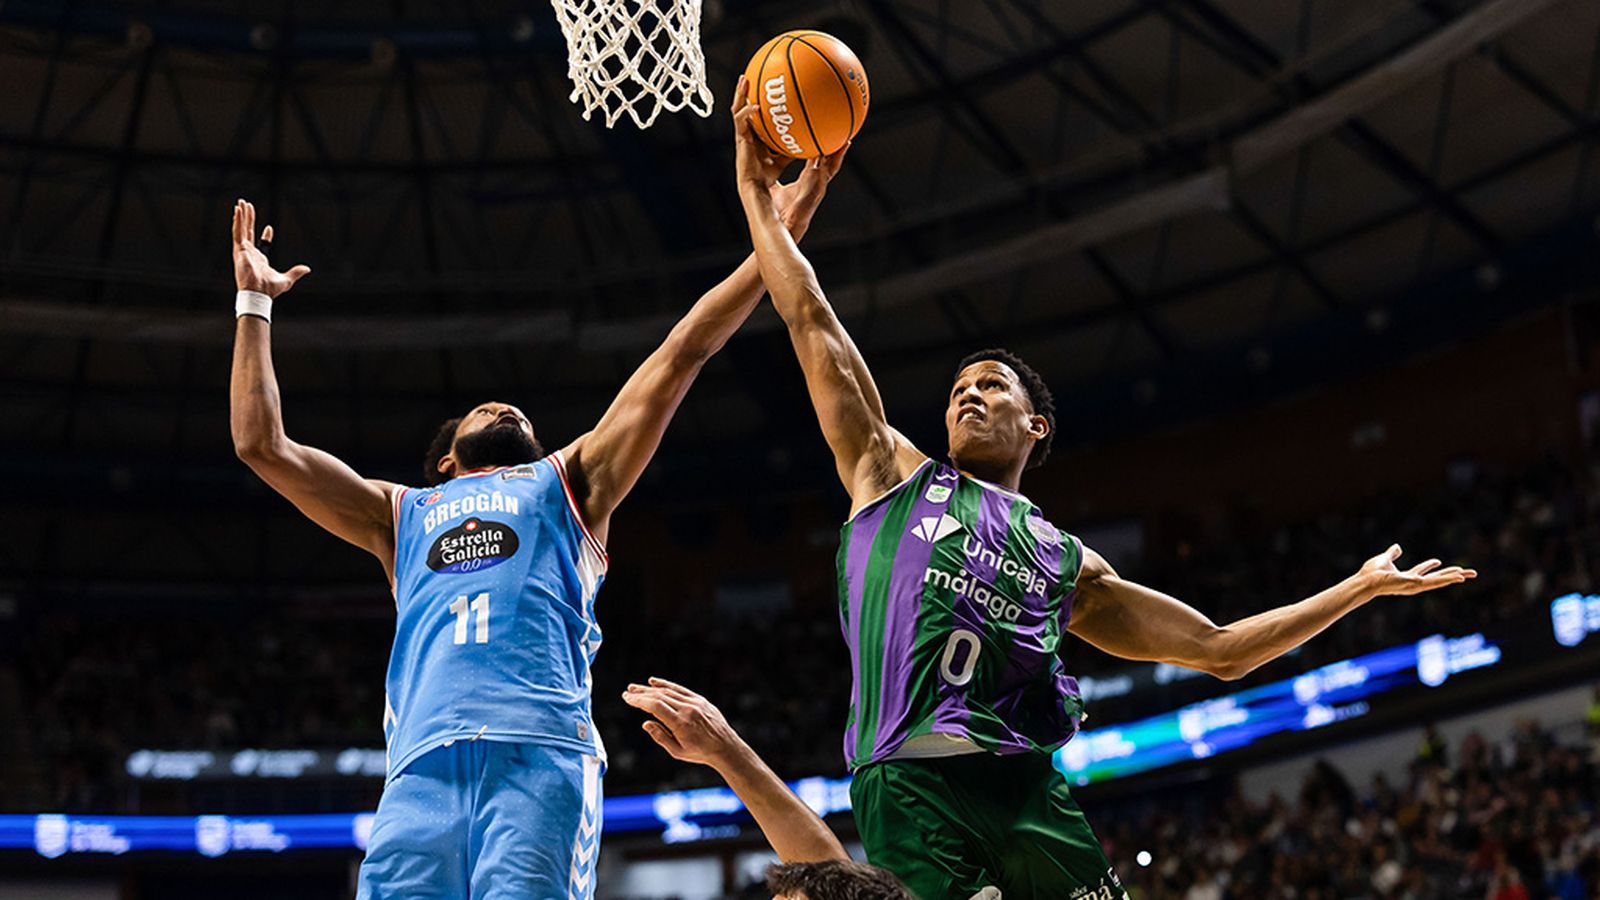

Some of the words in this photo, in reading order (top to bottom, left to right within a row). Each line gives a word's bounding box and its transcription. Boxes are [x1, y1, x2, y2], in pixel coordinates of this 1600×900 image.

[765, 75, 803, 154] Wilson
[423, 490, 519, 535] BREOGÁN
[440, 529, 504, 551] Estrella
[441, 542, 500, 564] Galicia
[962, 535, 1047, 597] Unicaja
[449, 593, 490, 645] 11
[924, 566, 1022, 623] málaga
[940, 629, 982, 687] 0
